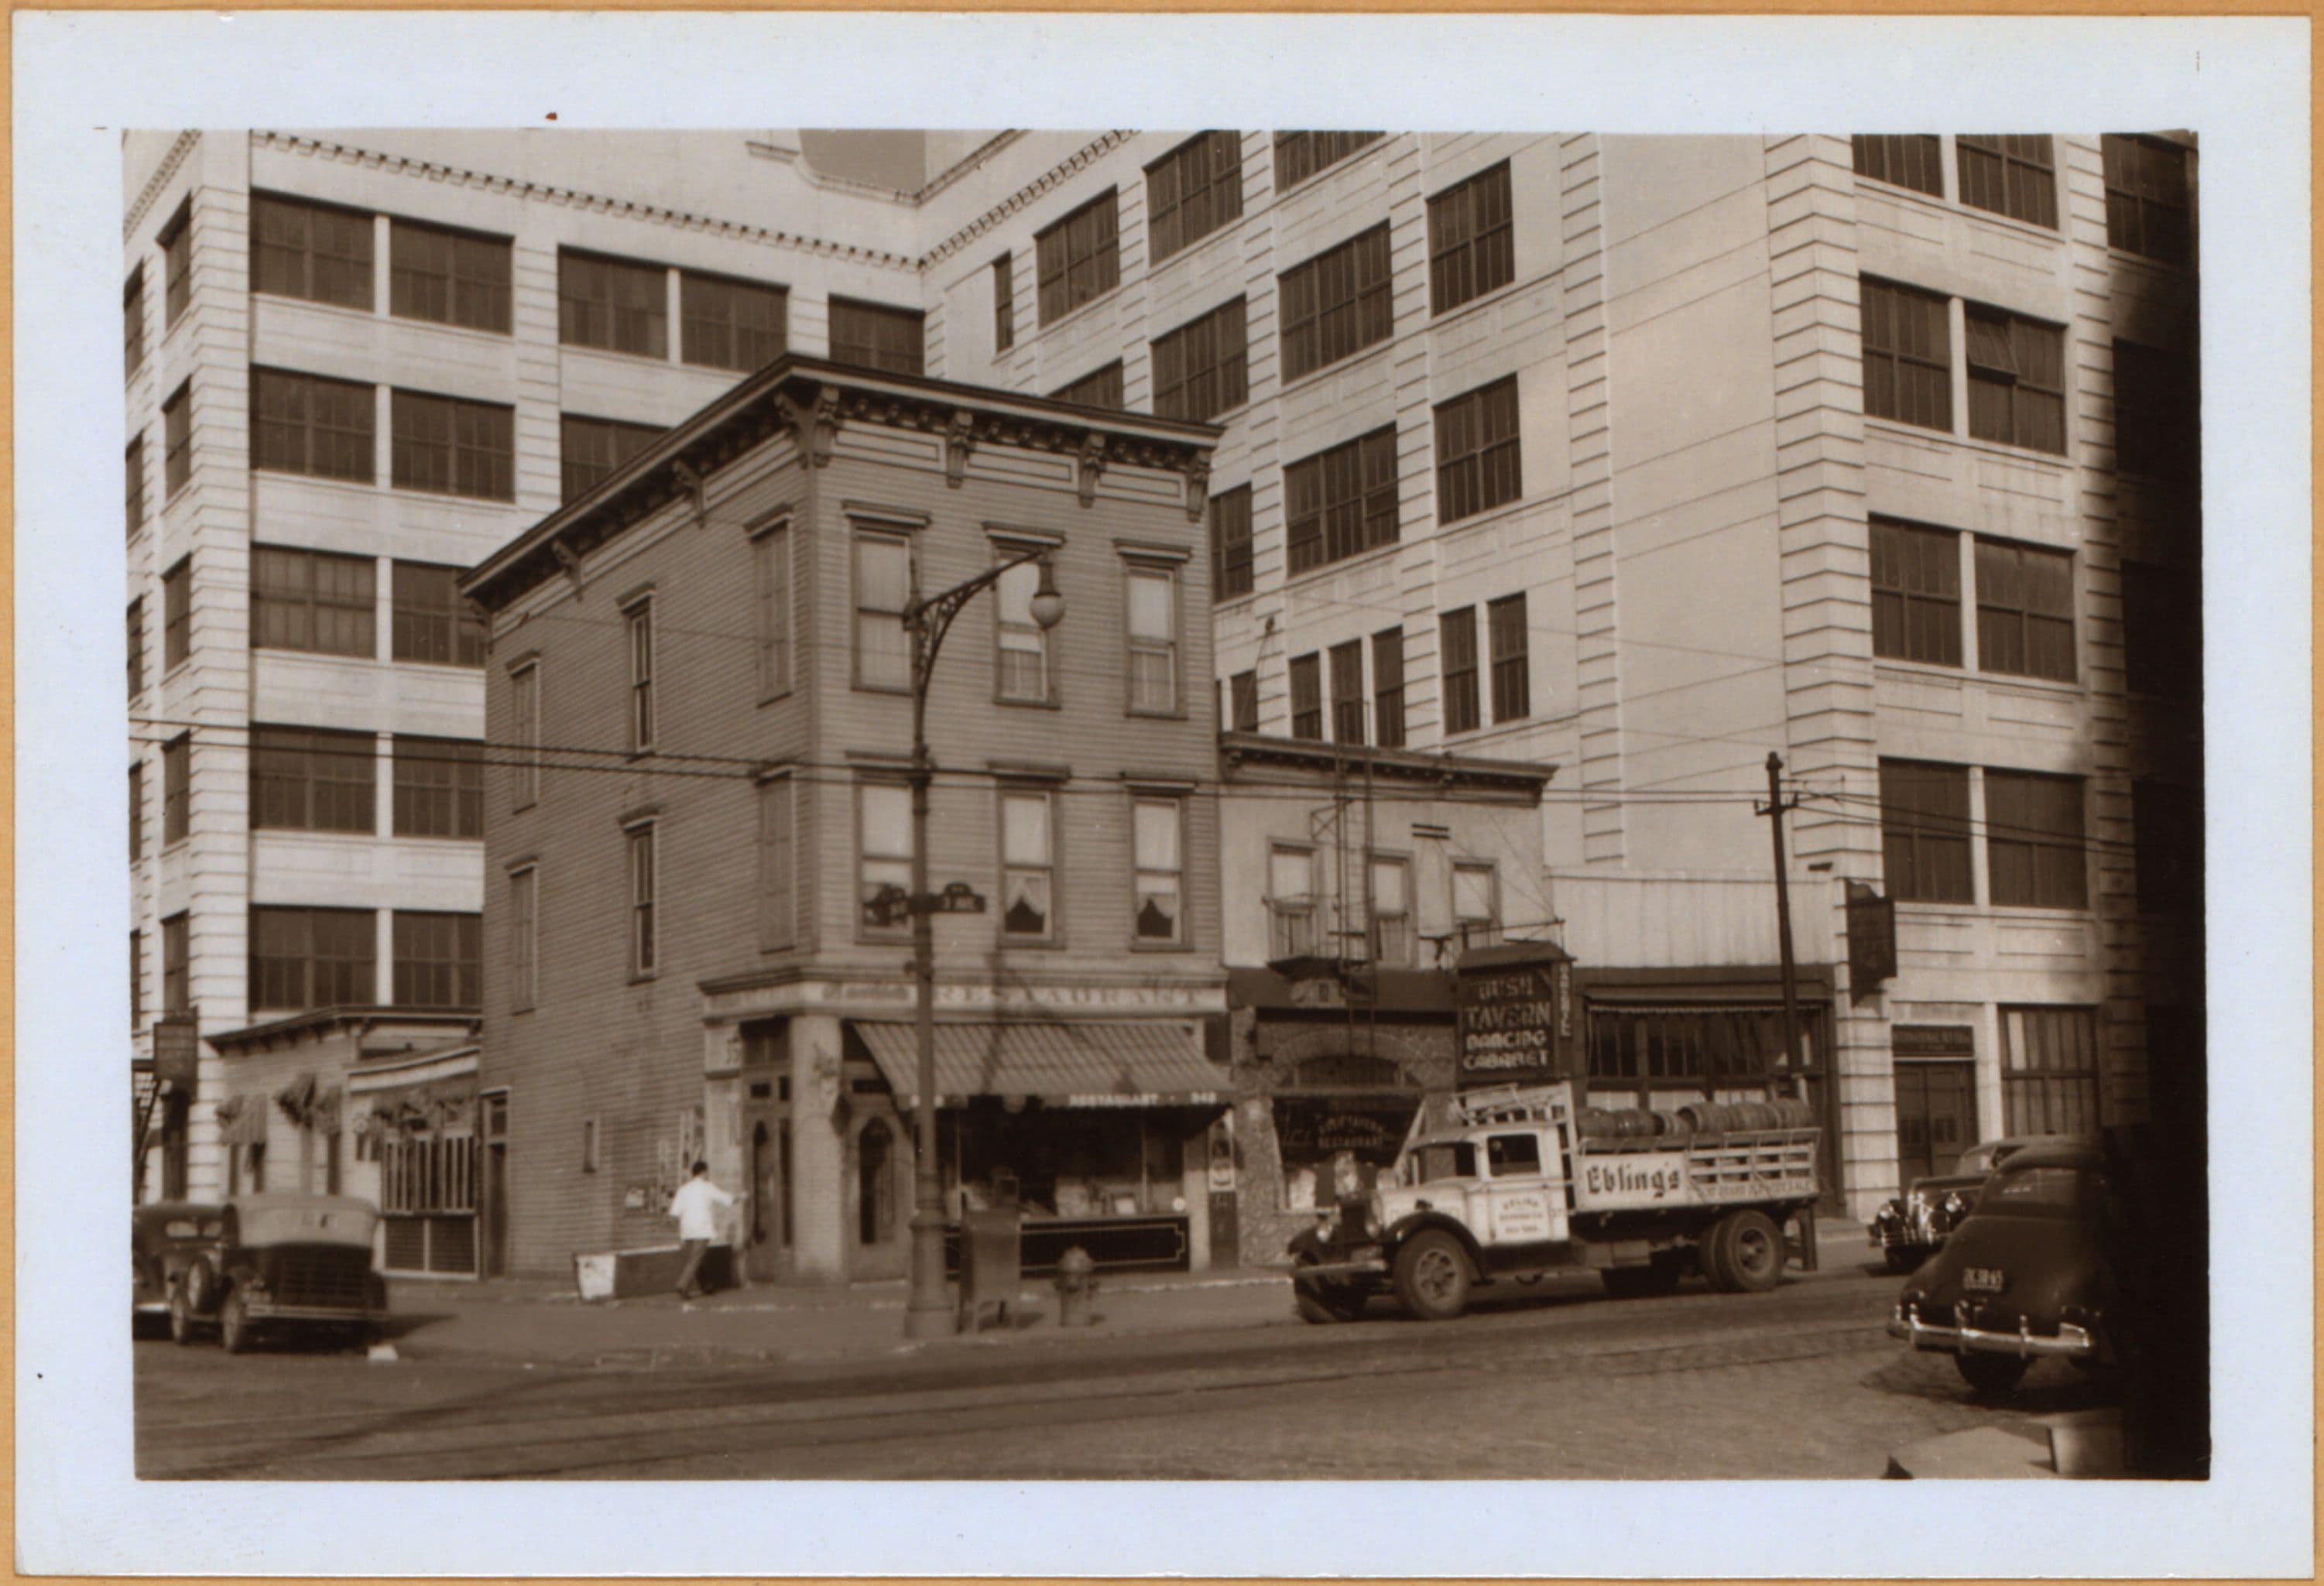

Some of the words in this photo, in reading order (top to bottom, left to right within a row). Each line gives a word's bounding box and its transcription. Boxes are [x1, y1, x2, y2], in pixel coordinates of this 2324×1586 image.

[1465, 1002, 1551, 1029] TAVERN
[1465, 1029, 1548, 1051] DANCING
[1463, 1050, 1548, 1070] CABARET
[1586, 1161, 1679, 1198] Ebling's
